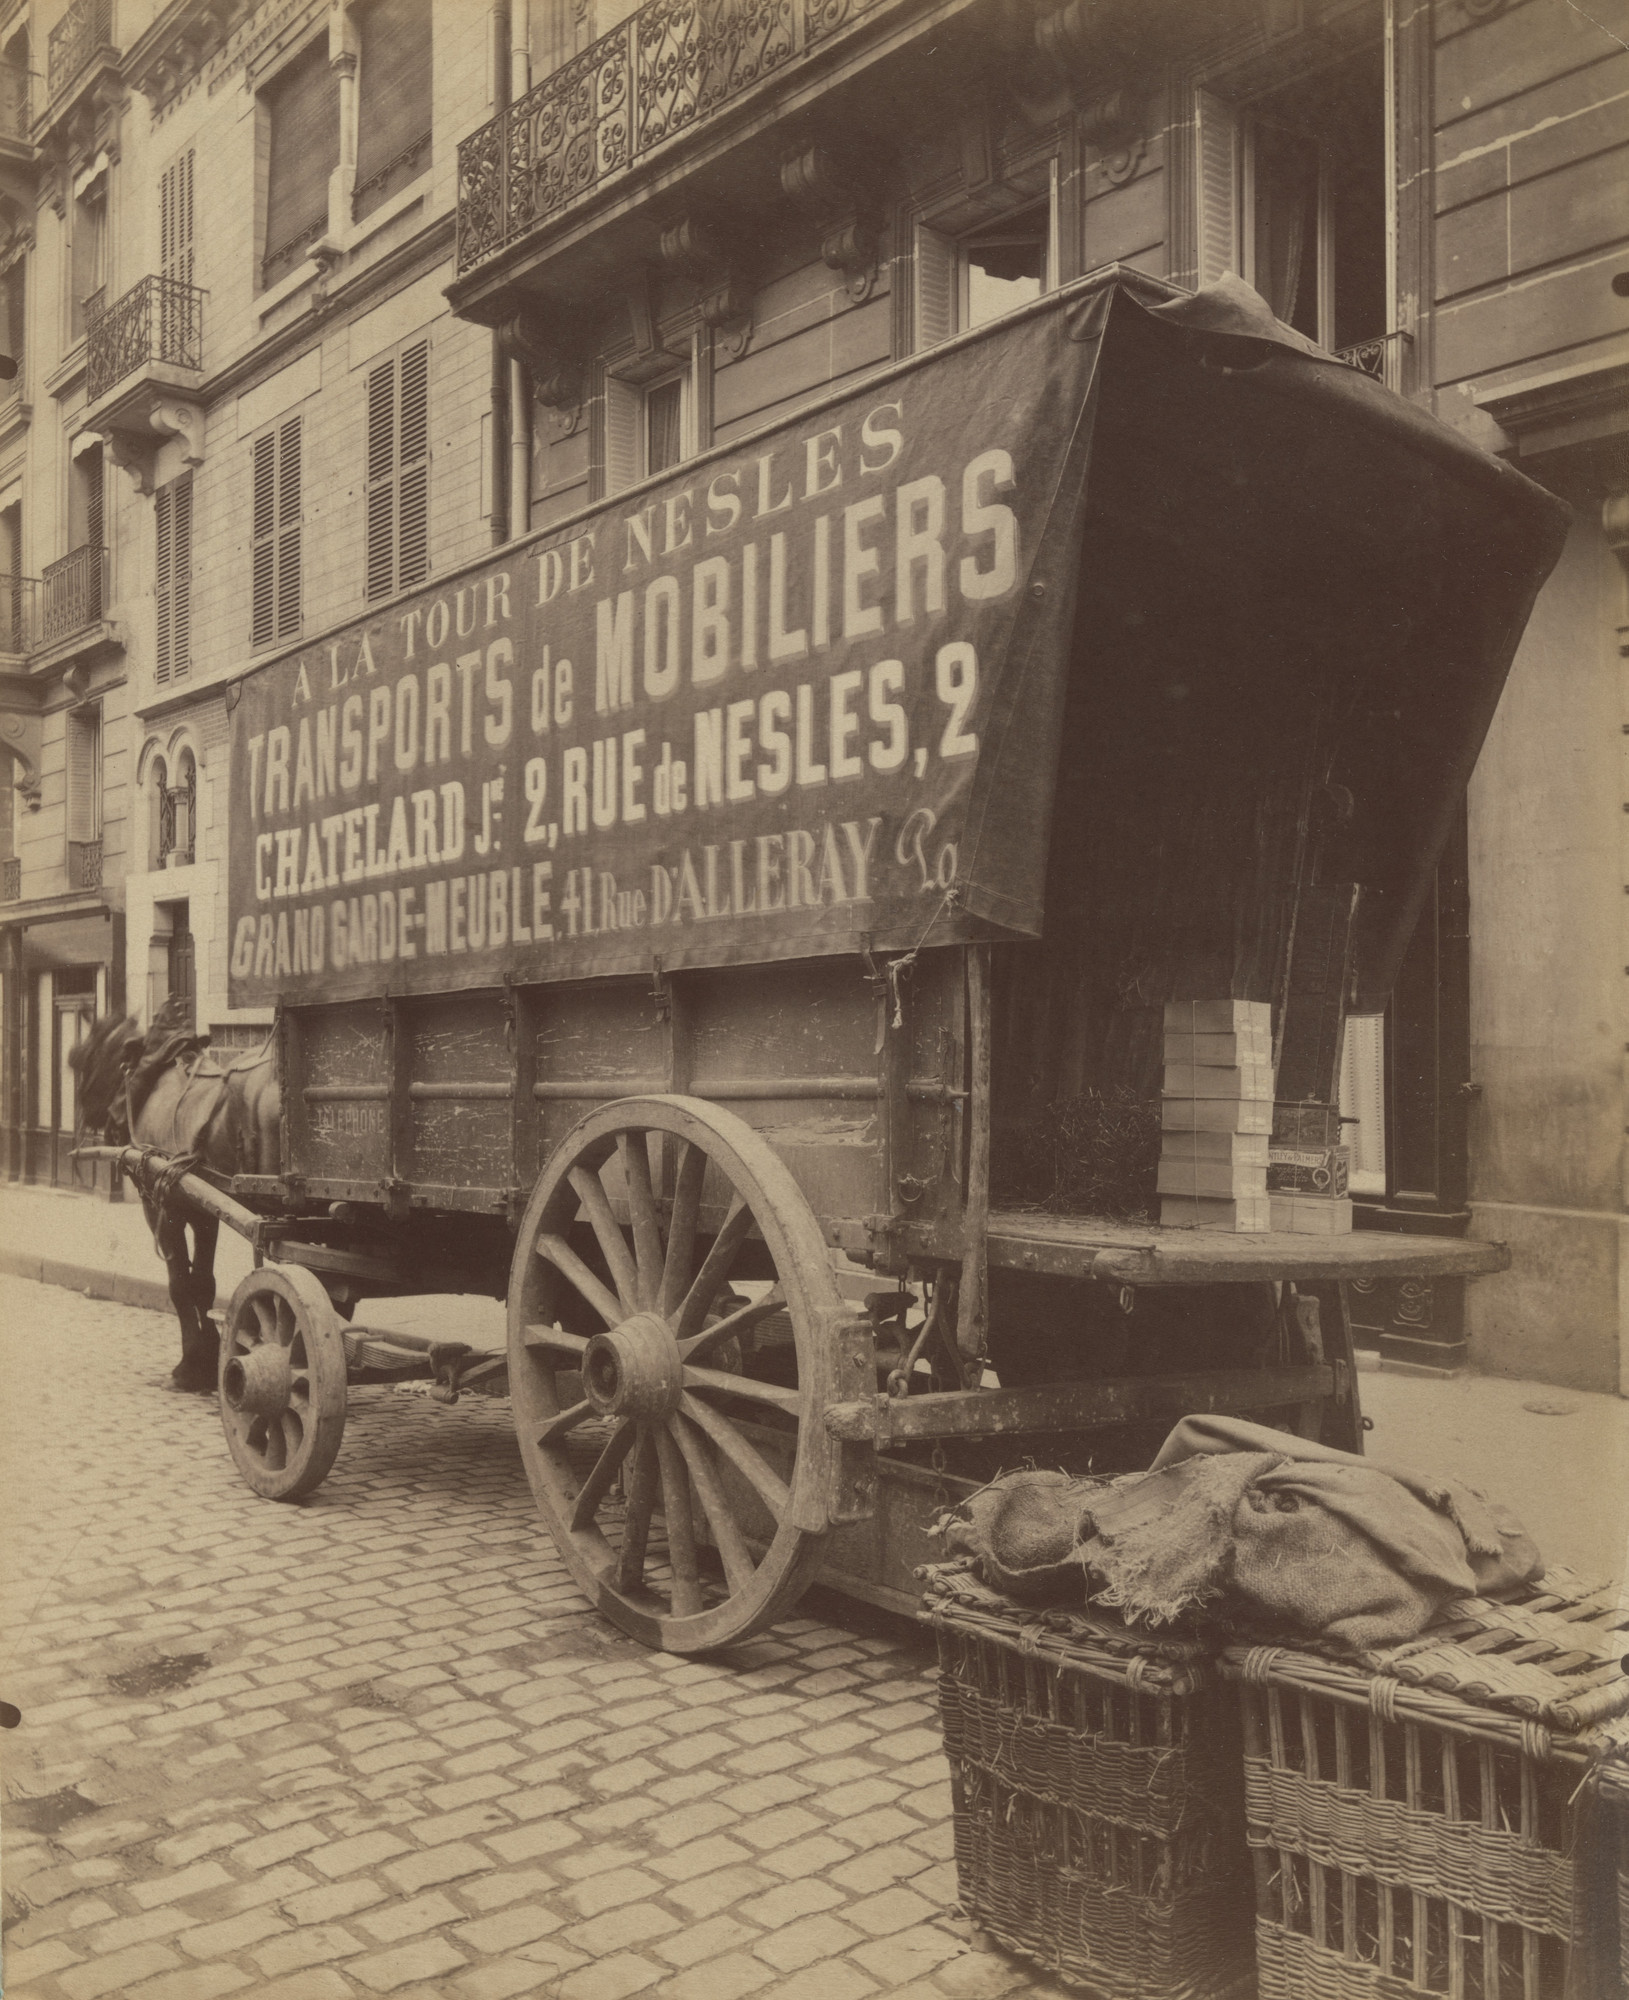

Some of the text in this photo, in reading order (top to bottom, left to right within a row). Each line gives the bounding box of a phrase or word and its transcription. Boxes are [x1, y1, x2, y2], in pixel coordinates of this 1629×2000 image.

[248, 448, 1020, 820] TRANSPORTS de MOBILIERS
[291, 398, 904, 708] A LA TOUR DE NESLES
[230, 904, 326, 980] GRAND
[600, 871, 648, 931] Rue
[648, 816, 883, 925] D'ALLERAY
[255, 780, 466, 901] CHATELARD
[523, 756, 559, 849] 2,
[562, 727, 648, 837] RUE
[653, 741, 689, 817] de
[693, 658, 928, 807] NESLES,
[935, 640, 979, 763] 2
